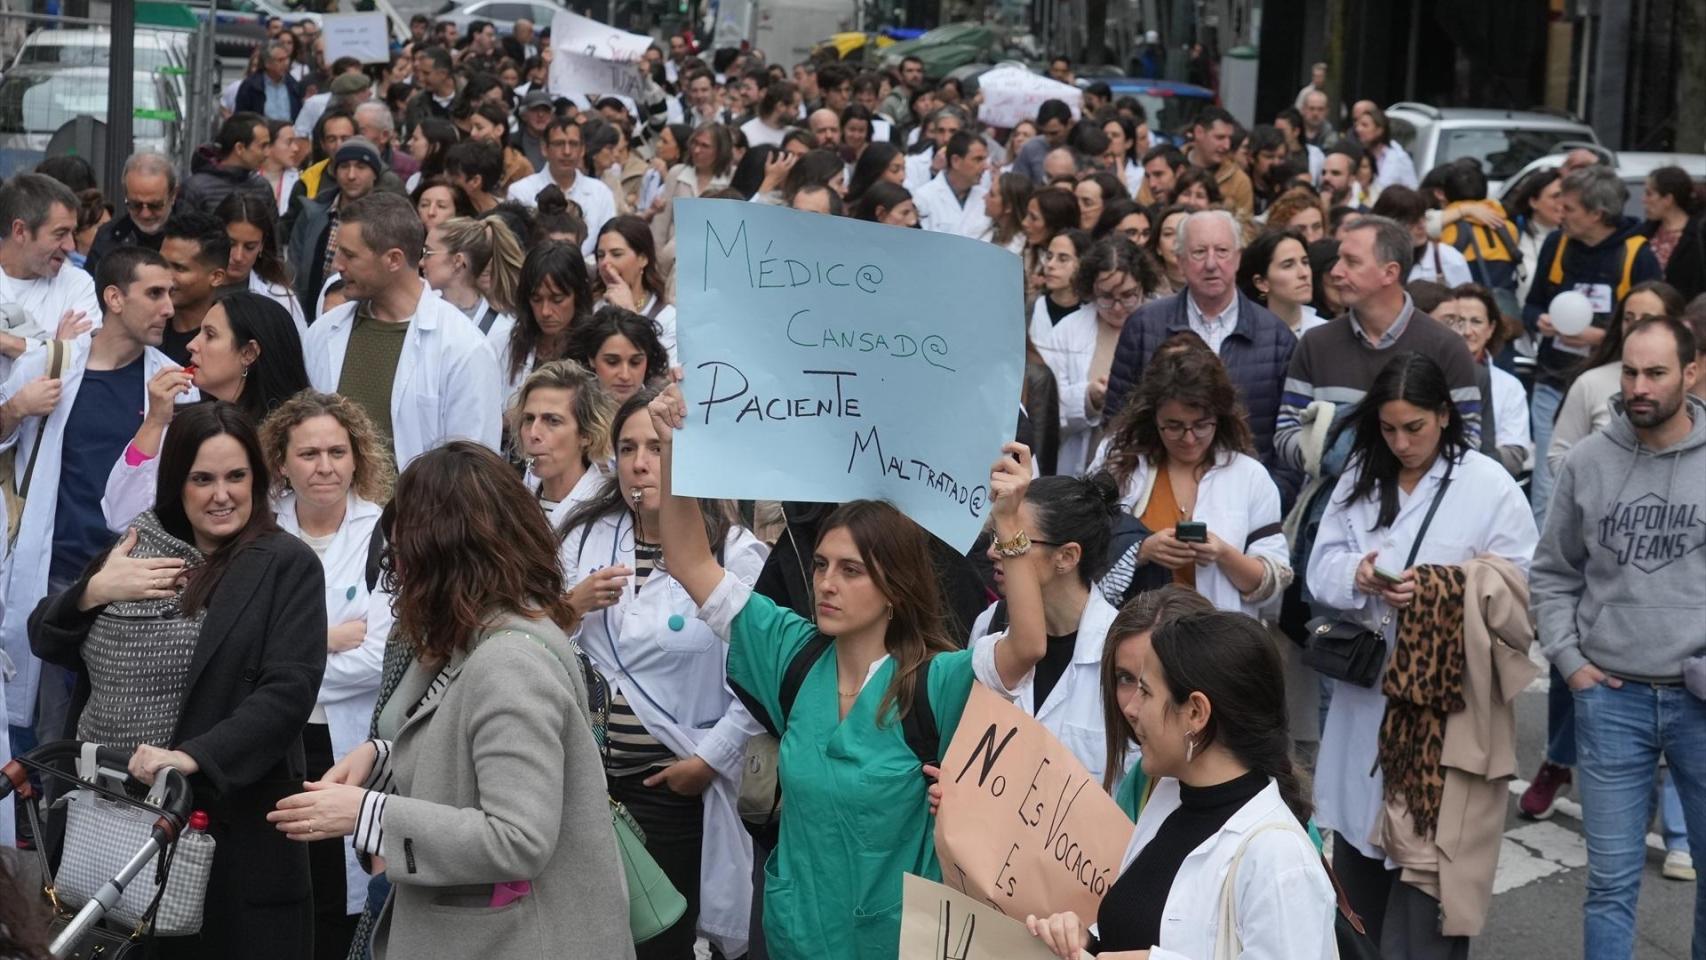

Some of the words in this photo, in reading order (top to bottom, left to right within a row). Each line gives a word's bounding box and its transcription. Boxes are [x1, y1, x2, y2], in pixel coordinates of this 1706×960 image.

[703, 219, 884, 294] MÉDIC@
[786, 309, 956, 372] CANSAD@
[696, 361, 862, 425] PACIENTE
[847, 425, 988, 518] MALTRATAD@
[1617, 531, 1687, 566] JEANS
[1043, 773, 1111, 897] VOCACIÓ
